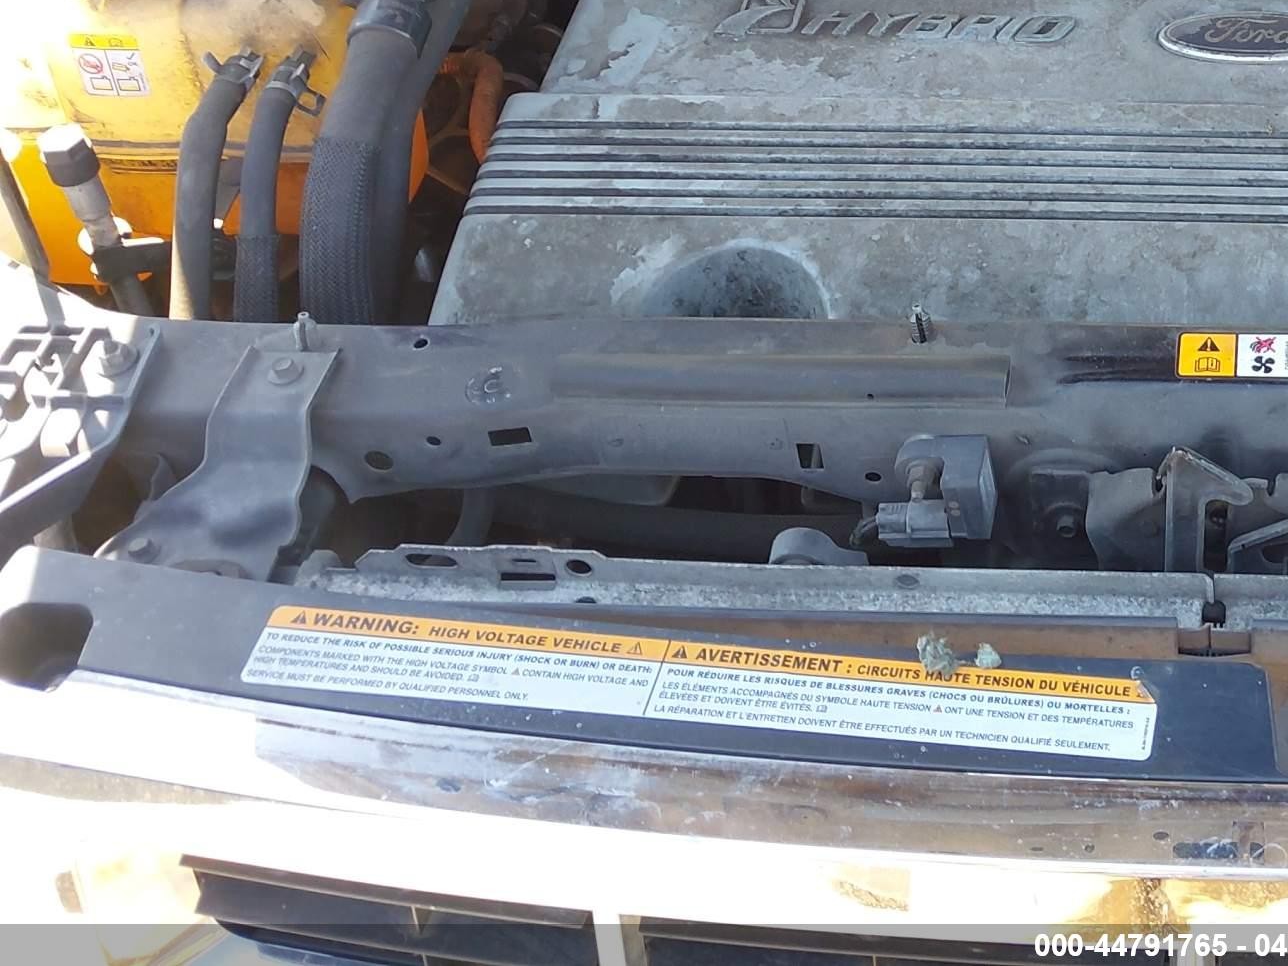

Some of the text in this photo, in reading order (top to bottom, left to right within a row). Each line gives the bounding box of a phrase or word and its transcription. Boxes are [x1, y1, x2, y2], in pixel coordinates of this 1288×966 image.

[801, 11, 1076, 42] HYBRID
[267, 632, 279, 640] TO
[281, 633, 319, 644] REDUCE
[322, 637, 341, 646] THE
[343, 639, 365, 648] RISK
[369, 641, 381, 649] OF
[383, 642, 429, 654] POSSIBLE
[432, 647, 473, 658] SERIOUS
[476, 651, 511, 661] INJURY
[514, 655, 550, 665] (SHOCK
[553, 658, 566, 666] OR
[569, 660, 599, 669] BURN)
[602, 663, 614, 671] OR
[313, 612, 621, 653] WARNING: HIGH VOLTAGE VEHICLE
[246, 668, 528, 701] SERVICE MUST BE PERFORMED BY QUALIFIED PERSONNEL ONLY.
[253, 654, 275, 663] HIGH
[277, 656, 348, 670] TEMPERATURES
[349, 663, 368, 672] AND
[370, 665, 406, 675] SHOULD
[409, 668, 421, 677] BE
[257, 645, 648, 687] COMPONENTS MARKED WITH THE HIGH VOLTAGE SYMBOL CONTAIN HIGH VOLTAGE AND
[694, 648, 842, 672] AVERTISSEMENT
[857, 665, 920, 679] CIRCUITS
[925, 670, 969, 683] HAUTE
[975, 674, 1034, 689] TENSION
[1039, 679, 1058, 691] DU
[1063, 680, 1130, 697] VÉHICULE
[662, 682, 1133, 729] LES ÉLÉMENTS ACCOMPAGNÉS DU SYMBOLE HAUTE TENSION ONT UNE TENSION ET DES TEMPÉRATURES
[667, 668, 693, 678] POUR
[697, 669, 740, 682] RÉDUIRE
[743, 675, 761, 683] LES
[764, 677, 807, 687] RISQUES
[810, 681, 822, 689] DE
[826, 682, 883, 694] BLESSURES
[886, 687, 925, 698] GRAVES
[928, 691, 966, 701] (CHOCS
[970, 694, 984, 703] OU
[1047, 701, 1060, 709] OU
[1064, 702, 1123, 714] MORTELLES
[654, 704, 665, 712] LA
[667, 704, 724, 718] RÉPARATION
[726, 711, 738, 719] ET
[739, 712, 795, 724] L'ENTRETIEN
[798, 717, 837, 727] DOIVENT
[839, 719, 862, 729] ÊTRE
[864, 721, 918, 734] EFFECTUÉS
[920, 727, 938, 736] PAR
[940, 729, 953, 737] UN
[955, 731, 1009, 742] TECHNICIEN
[1011, 734, 1052, 746] QUALIFIÉ
